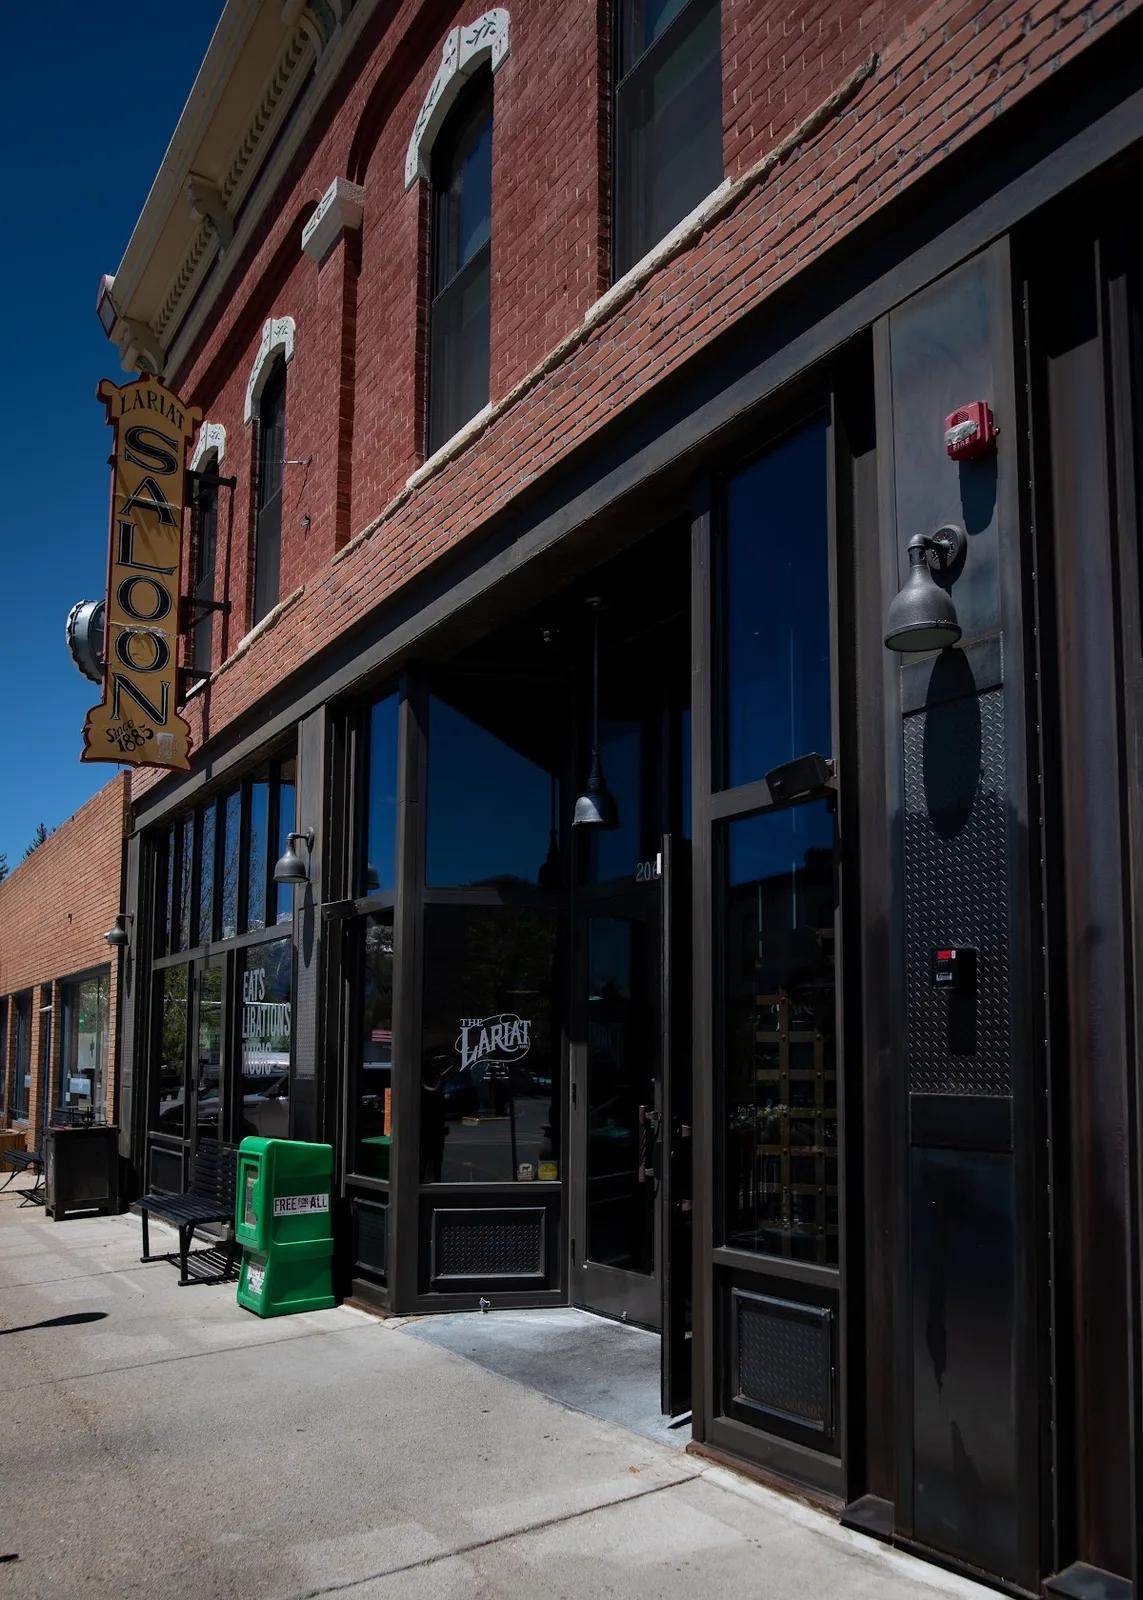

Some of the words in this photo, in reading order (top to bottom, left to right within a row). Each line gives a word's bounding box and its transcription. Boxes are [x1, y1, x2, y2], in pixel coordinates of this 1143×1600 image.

[120, 389, 185, 432] LARIAT
[952, 437, 970, 451] FIRE
[112, 425, 179, 726] SALOON
[106, 719, 134, 742] Since
[117, 723, 153, 752] 1885
[242, 967, 265, 1002] EATS
[242, 1002, 291, 1038] LIBATIONS
[460, 1018, 483, 1027] THE
[459, 1020, 531, 1072] LARIAT
[274, 1197, 297, 1212] FREE
[298, 1197, 308, 1205] FOR
[310, 1196, 328, 1209] ALL
